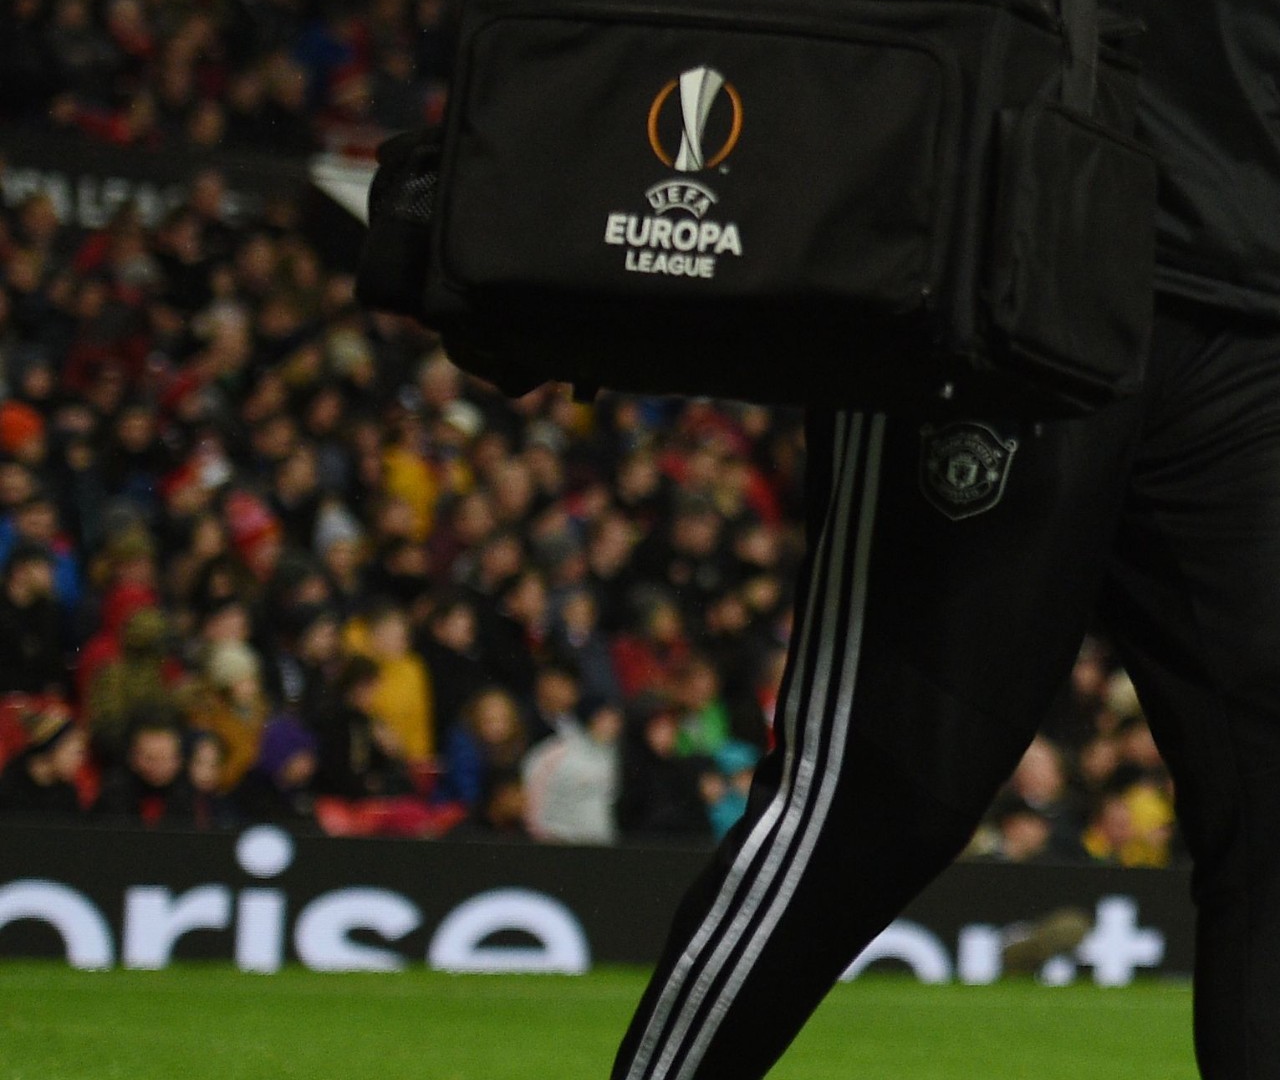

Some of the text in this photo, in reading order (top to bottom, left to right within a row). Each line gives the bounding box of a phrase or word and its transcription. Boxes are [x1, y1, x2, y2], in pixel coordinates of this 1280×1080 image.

[648, 185, 711, 218] UEFA
[604, 212, 743, 257] EUROPA
[624, 248, 717, 279] LEAGUE
